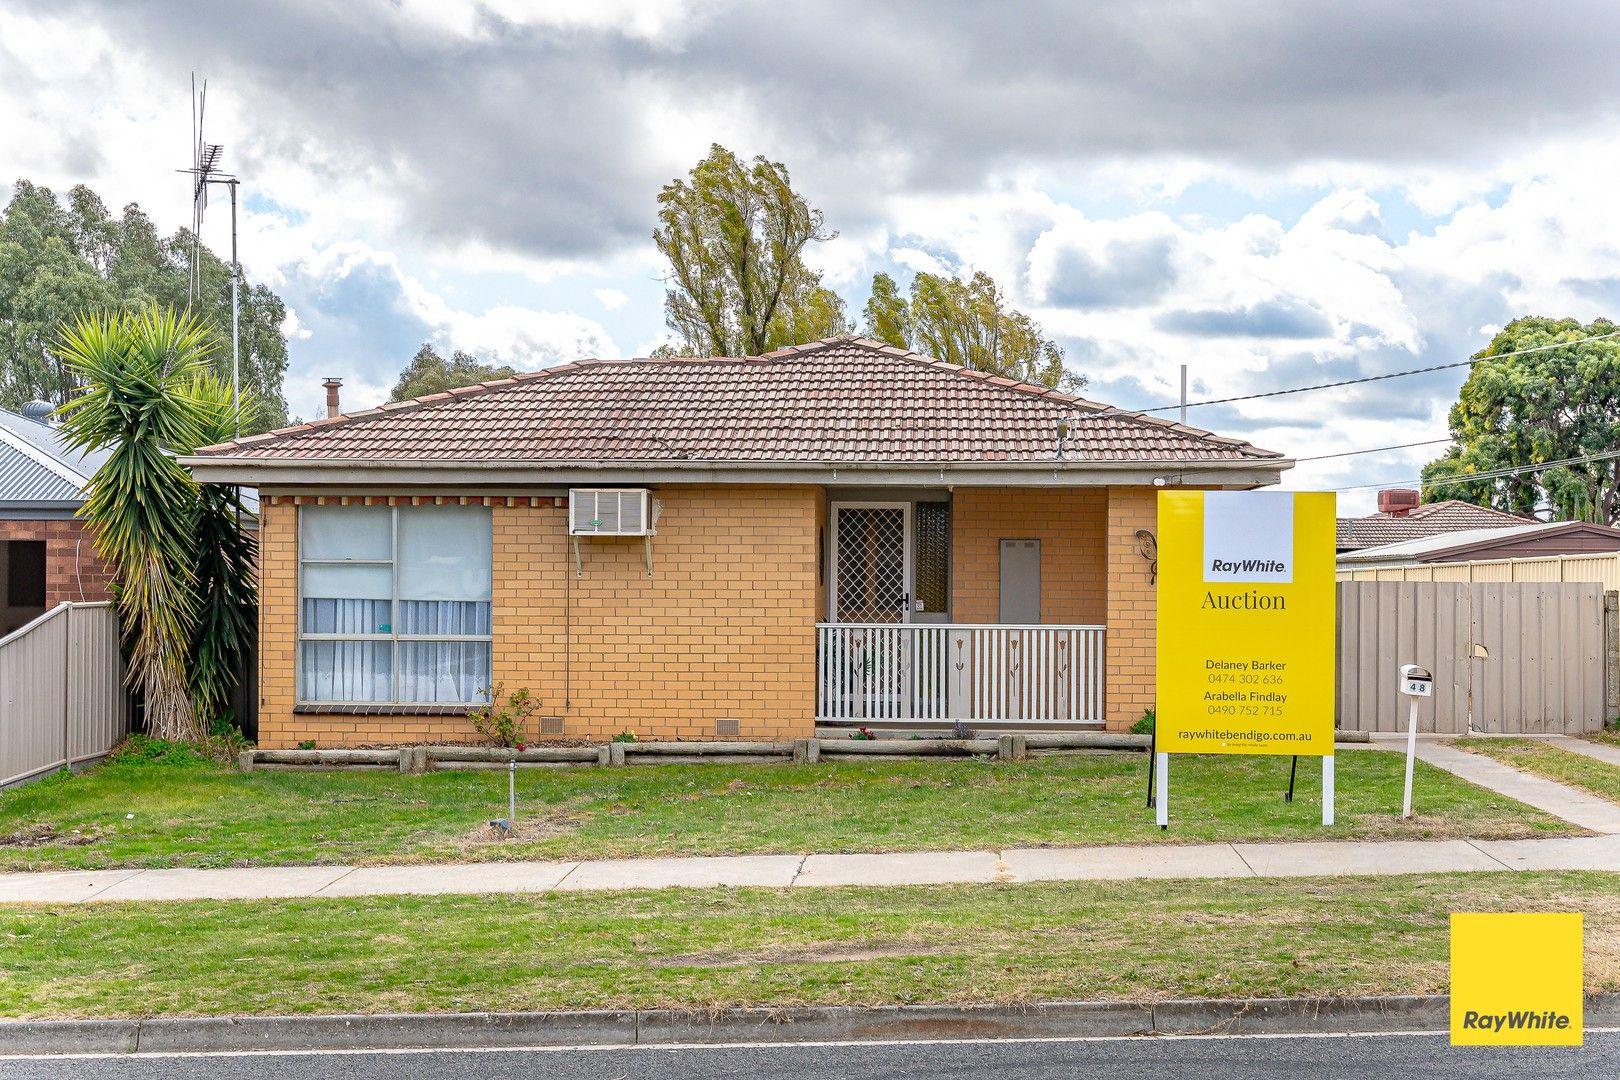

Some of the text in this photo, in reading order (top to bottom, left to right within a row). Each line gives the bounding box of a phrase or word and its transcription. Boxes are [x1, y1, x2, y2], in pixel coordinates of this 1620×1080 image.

[1201, 591, 1286, 610] Auction
[1205, 659, 1287, 671] Delaney Barker
[1207, 674, 1283, 685] 0474 302 636
[1203, 691, 1288, 703] Arabella Findlay
[1207, 705, 1283, 716] 0490 752 715
[1178, 729, 1312, 742] raywhitebendigo.com.au
